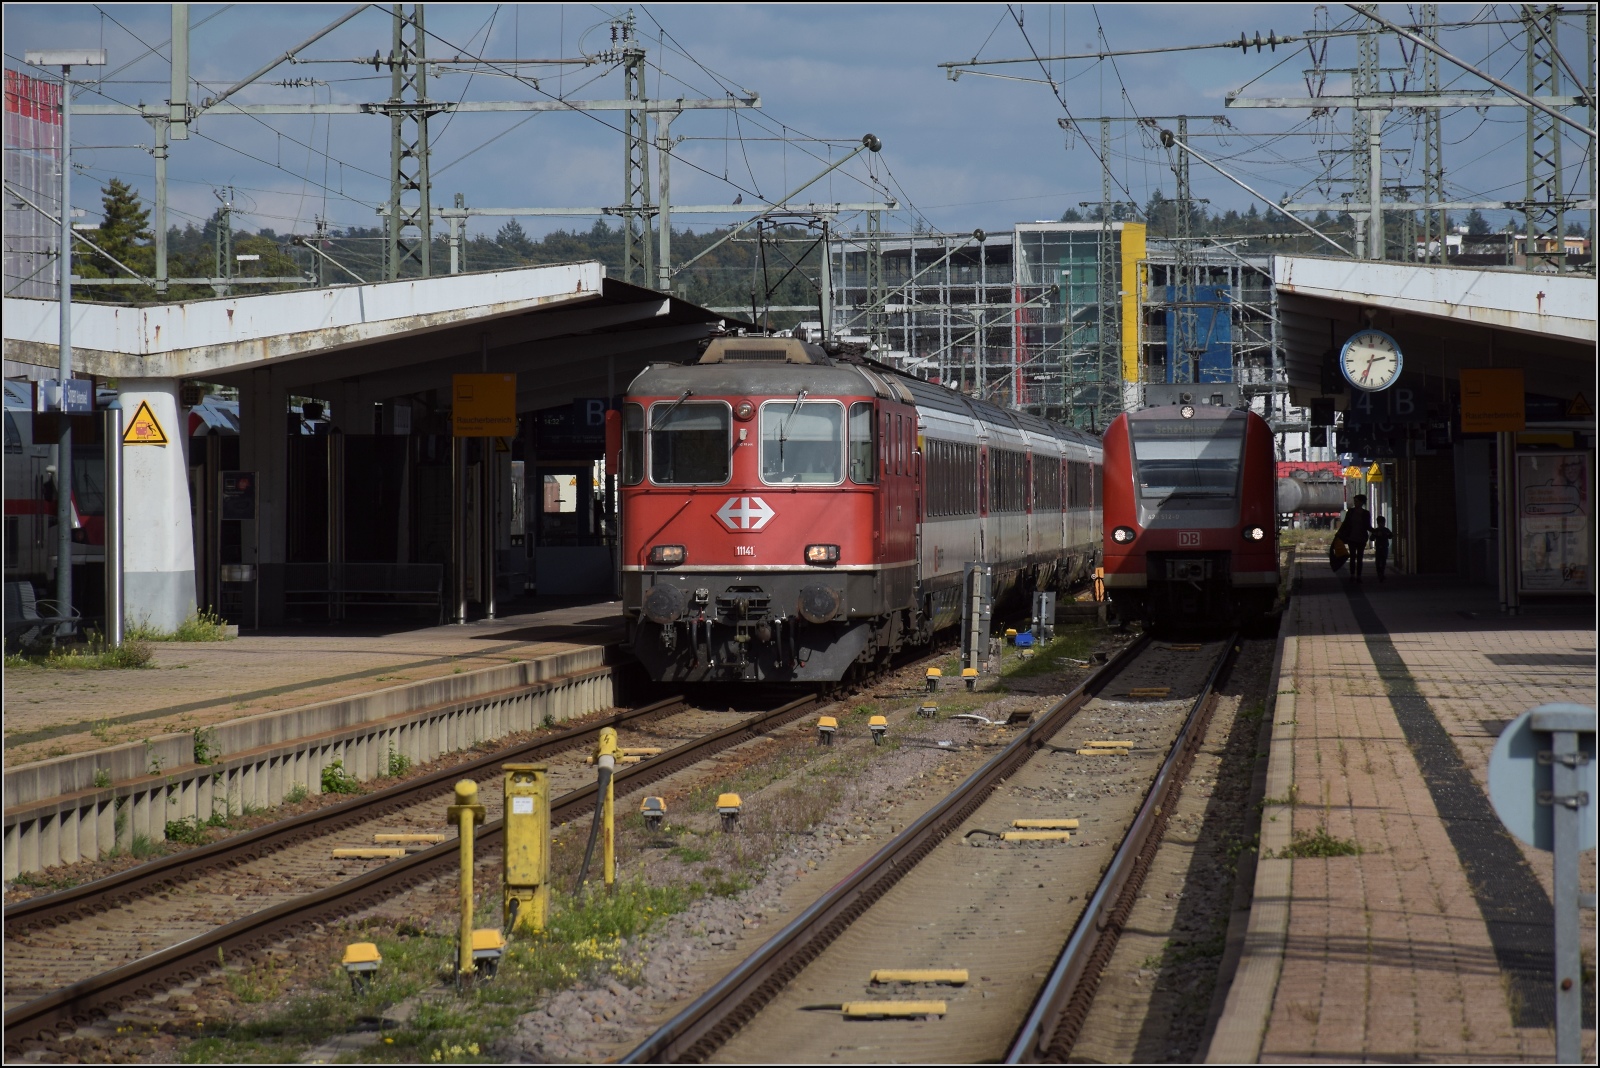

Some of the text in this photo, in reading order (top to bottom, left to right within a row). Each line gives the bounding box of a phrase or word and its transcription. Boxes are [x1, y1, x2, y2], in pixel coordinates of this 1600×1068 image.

[1356, 389, 1415, 415] 4 B
[587, 400, 605, 426] B
[1465, 411, 1521, 419] Raucherbereich
[456, 416, 512, 424] Raucherbereich
[1154, 423, 1224, 433] Schaffhausen
[1180, 532, 1200, 545] DB
[736, 546, 754, 556] 11141
